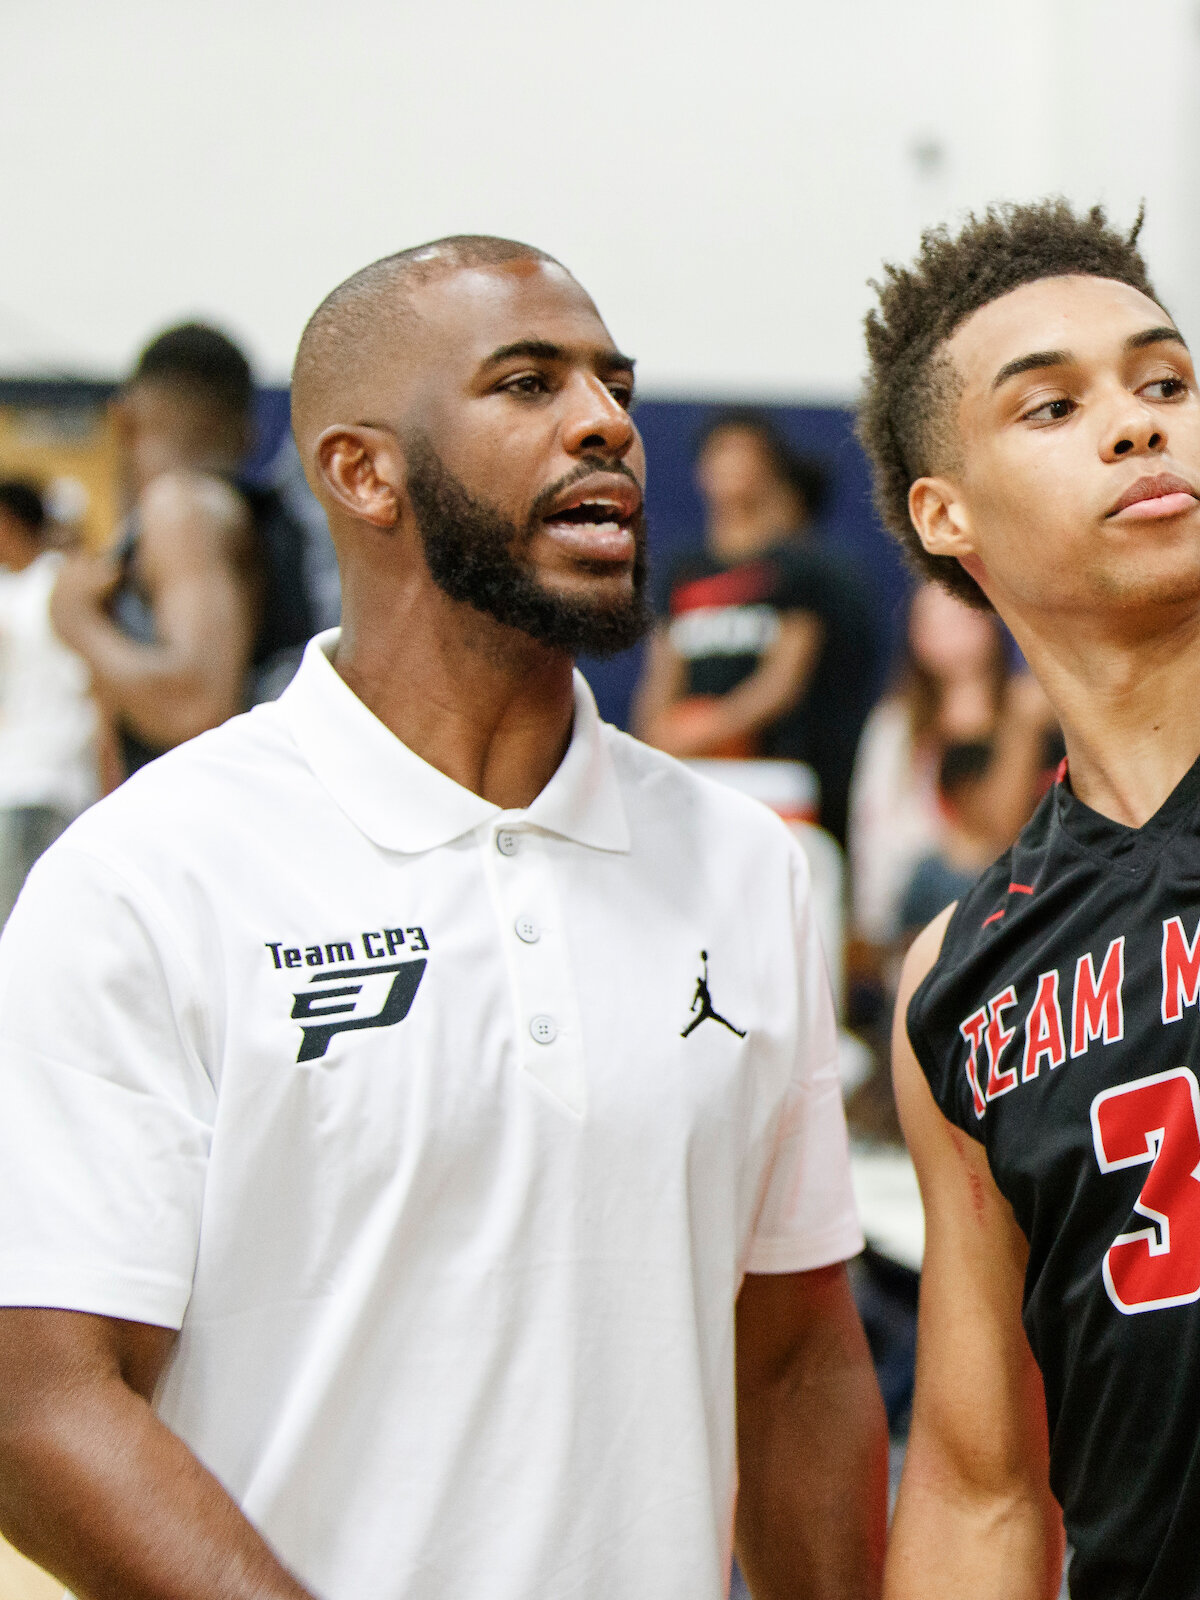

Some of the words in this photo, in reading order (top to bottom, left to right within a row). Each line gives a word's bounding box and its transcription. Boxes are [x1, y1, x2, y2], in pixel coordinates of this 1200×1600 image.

[264, 942, 355, 969] Team
[361, 926, 430, 959] CP3
[959, 935, 1126, 1121] TEAM
